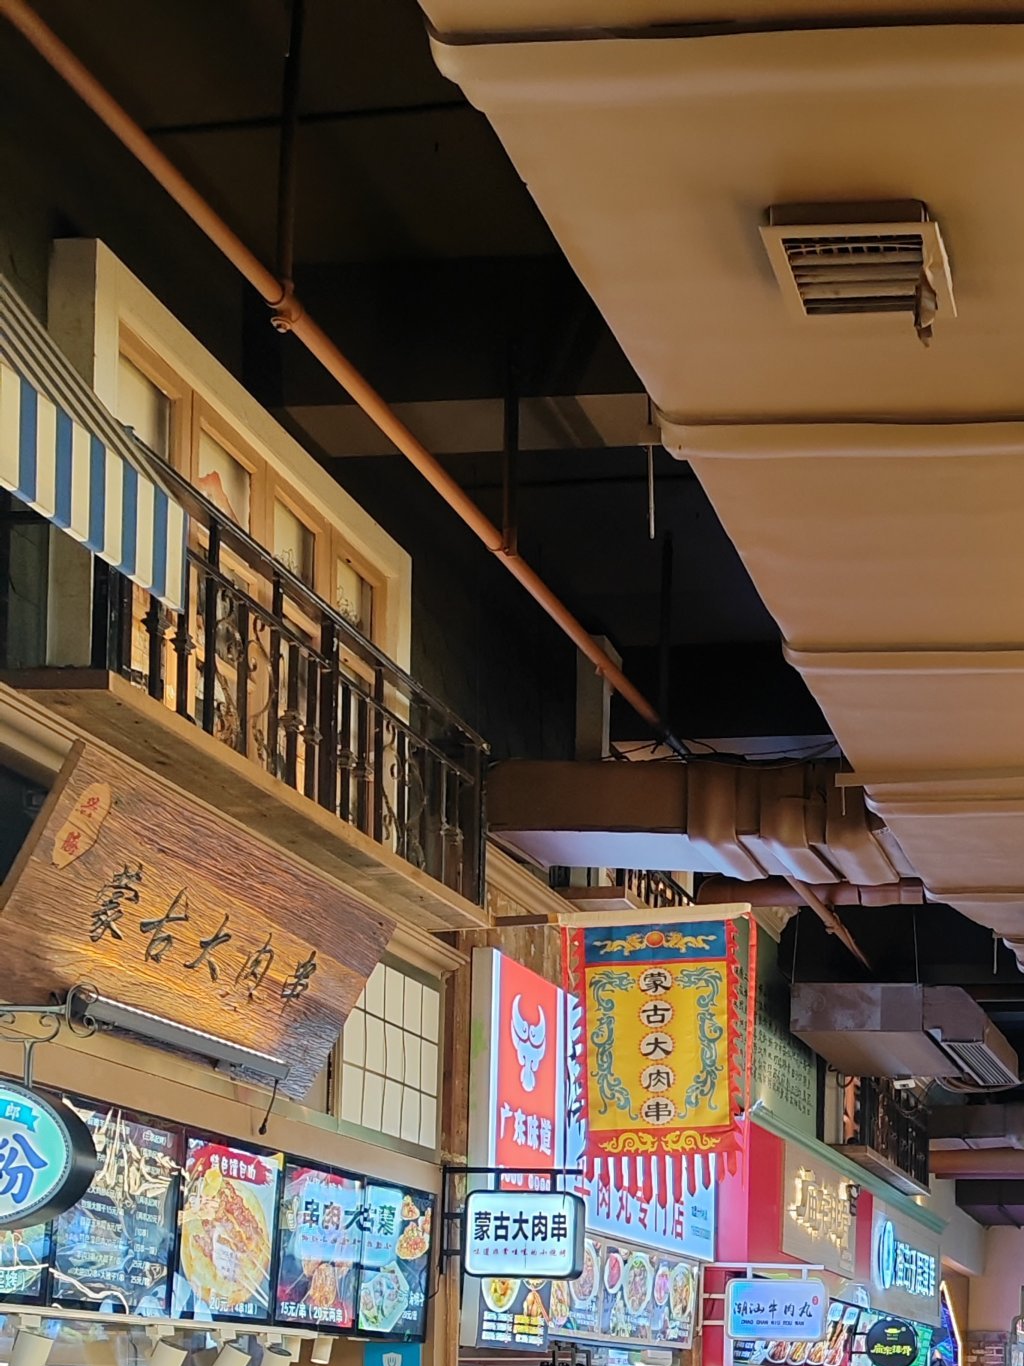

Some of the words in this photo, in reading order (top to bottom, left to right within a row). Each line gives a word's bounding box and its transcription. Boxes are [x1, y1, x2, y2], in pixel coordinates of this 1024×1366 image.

[89, 860, 318, 1013] 蒙古大肉串
[642, 970, 674, 1122] 蒙古大肉串
[500, 1102, 552, 1156] 广东味道
[474, 1211, 567, 1243] 蒙古大肉串
[733, 1299, 813, 1320] 潮汕牛肉丸
